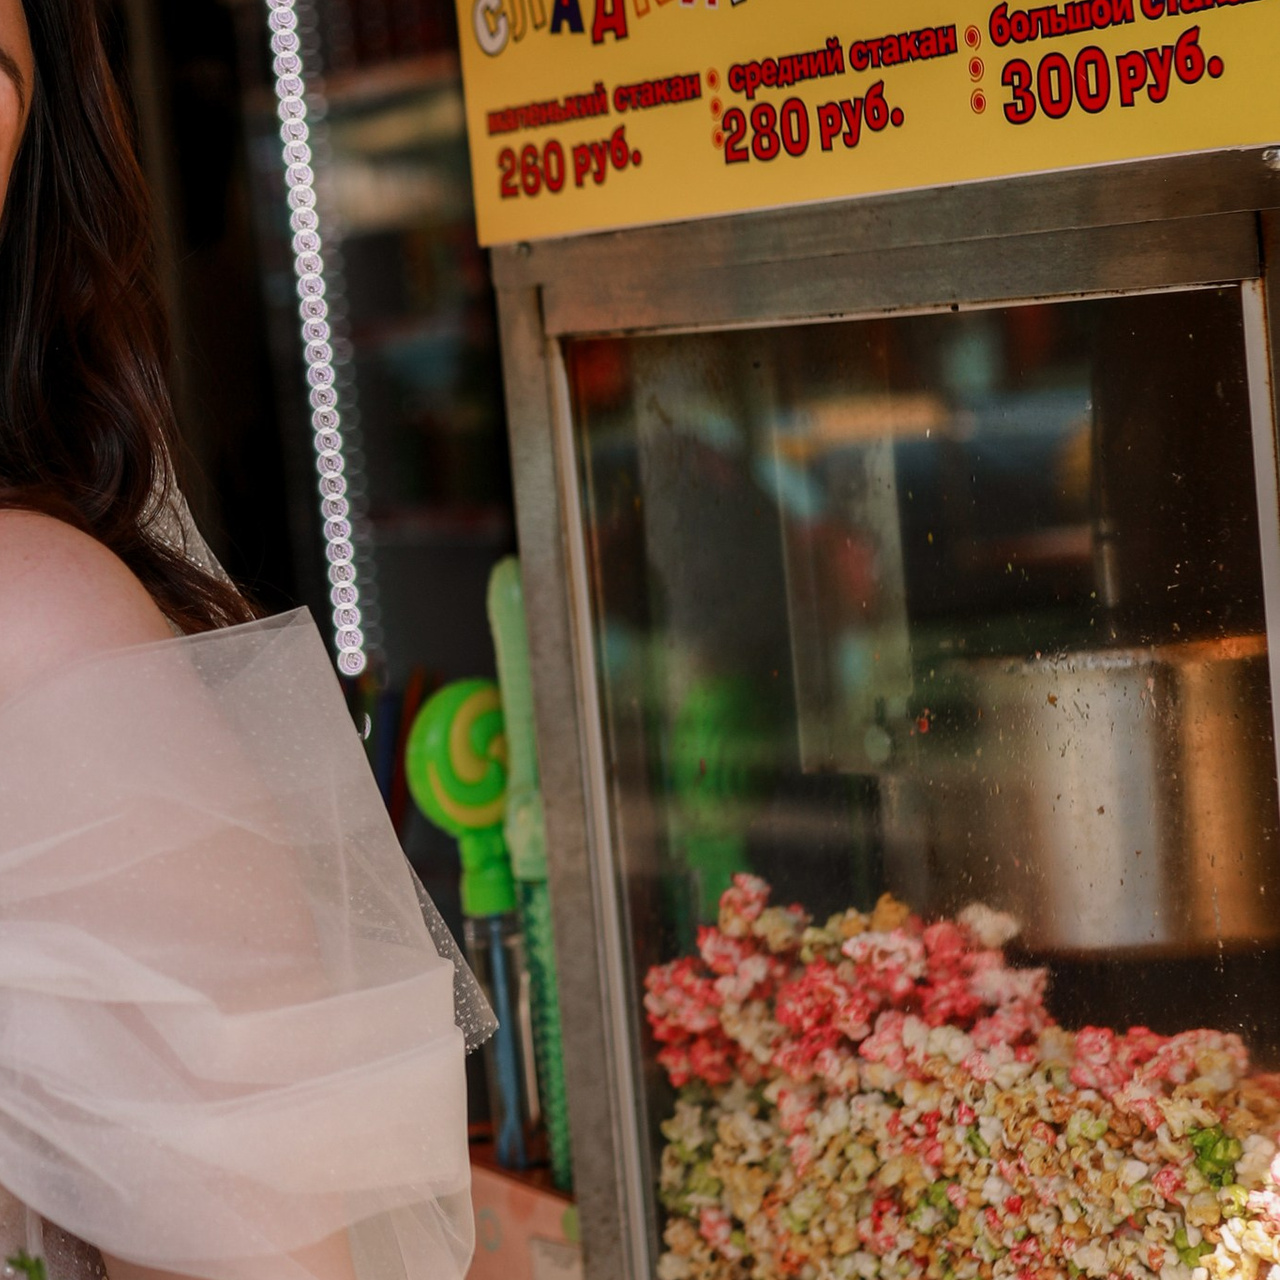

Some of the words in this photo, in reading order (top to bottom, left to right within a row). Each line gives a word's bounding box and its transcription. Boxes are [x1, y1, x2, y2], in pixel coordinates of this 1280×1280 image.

[728, 36, 845, 100] средний
[849, 24, 958, 71] стакан
[1001, 45, 1111, 125] 300
[1116, 25, 1224, 107] руб.
[487, 81, 609, 137] маленький
[613, 73, 702, 114] стакан
[722, 97, 810, 165] 280
[816, 80, 905, 151] руб.
[498, 139, 566, 199] 260
[572, 124, 642, 188] руб.
